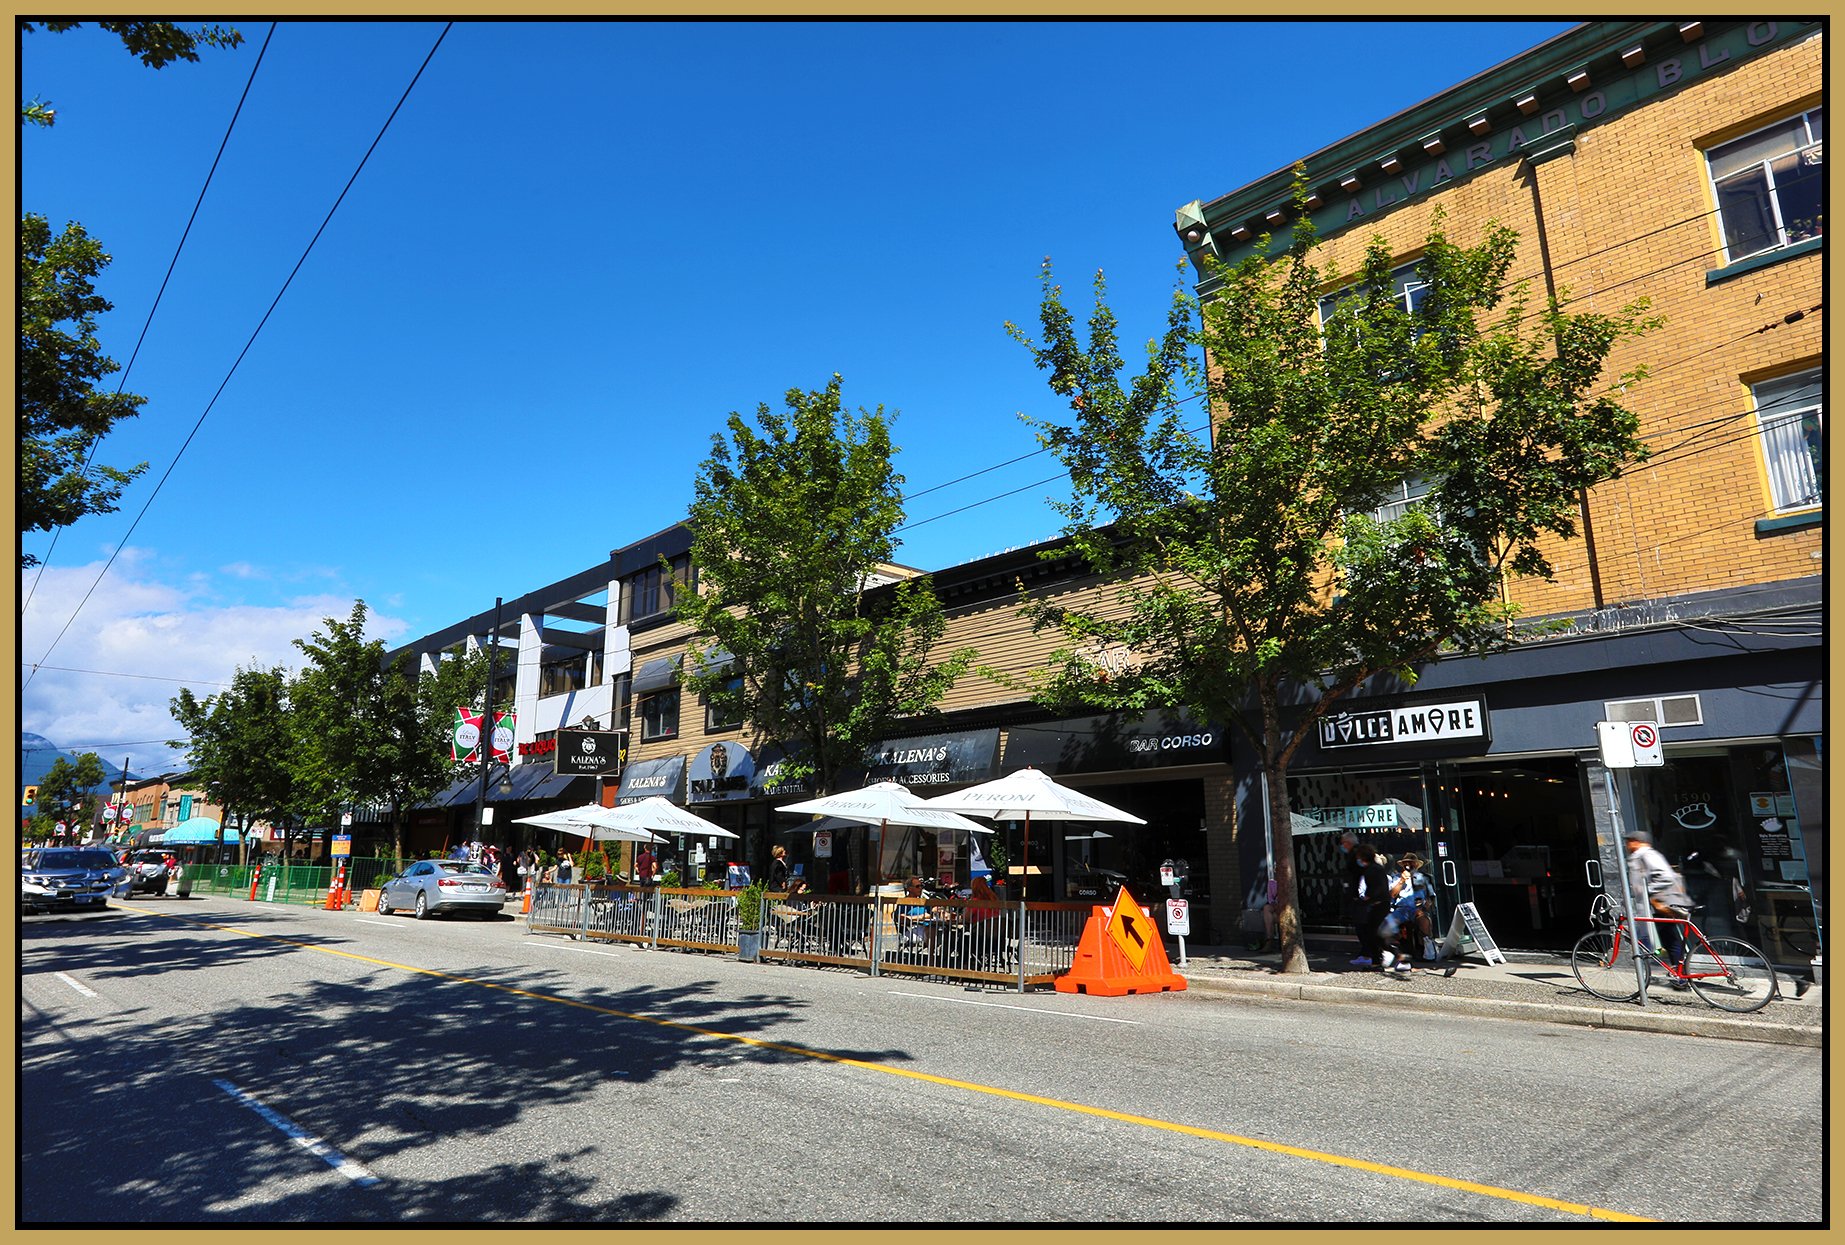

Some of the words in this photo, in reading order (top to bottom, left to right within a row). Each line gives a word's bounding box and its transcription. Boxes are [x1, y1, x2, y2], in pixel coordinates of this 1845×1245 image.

[1346, 91, 1606, 222] ALVARADO
[1656, 22, 1812, 88] BLO
[1398, 708, 1475, 735] AMORE
[530, 738, 556, 755] LIQUO
[1130, 738, 1159, 752] BAR
[1161, 733, 1212, 749] CORSO
[571, 755, 606, 765] KALENA'S
[879, 746, 947, 766] KALENA'S
[628, 775, 667, 789] KALENA'S
[898, 772, 950, 784] ACCESSORIES
[962, 792, 1036, 801] PERONI
[821, 800, 877, 810] PERONI
[655, 816, 704, 828] PERONI
